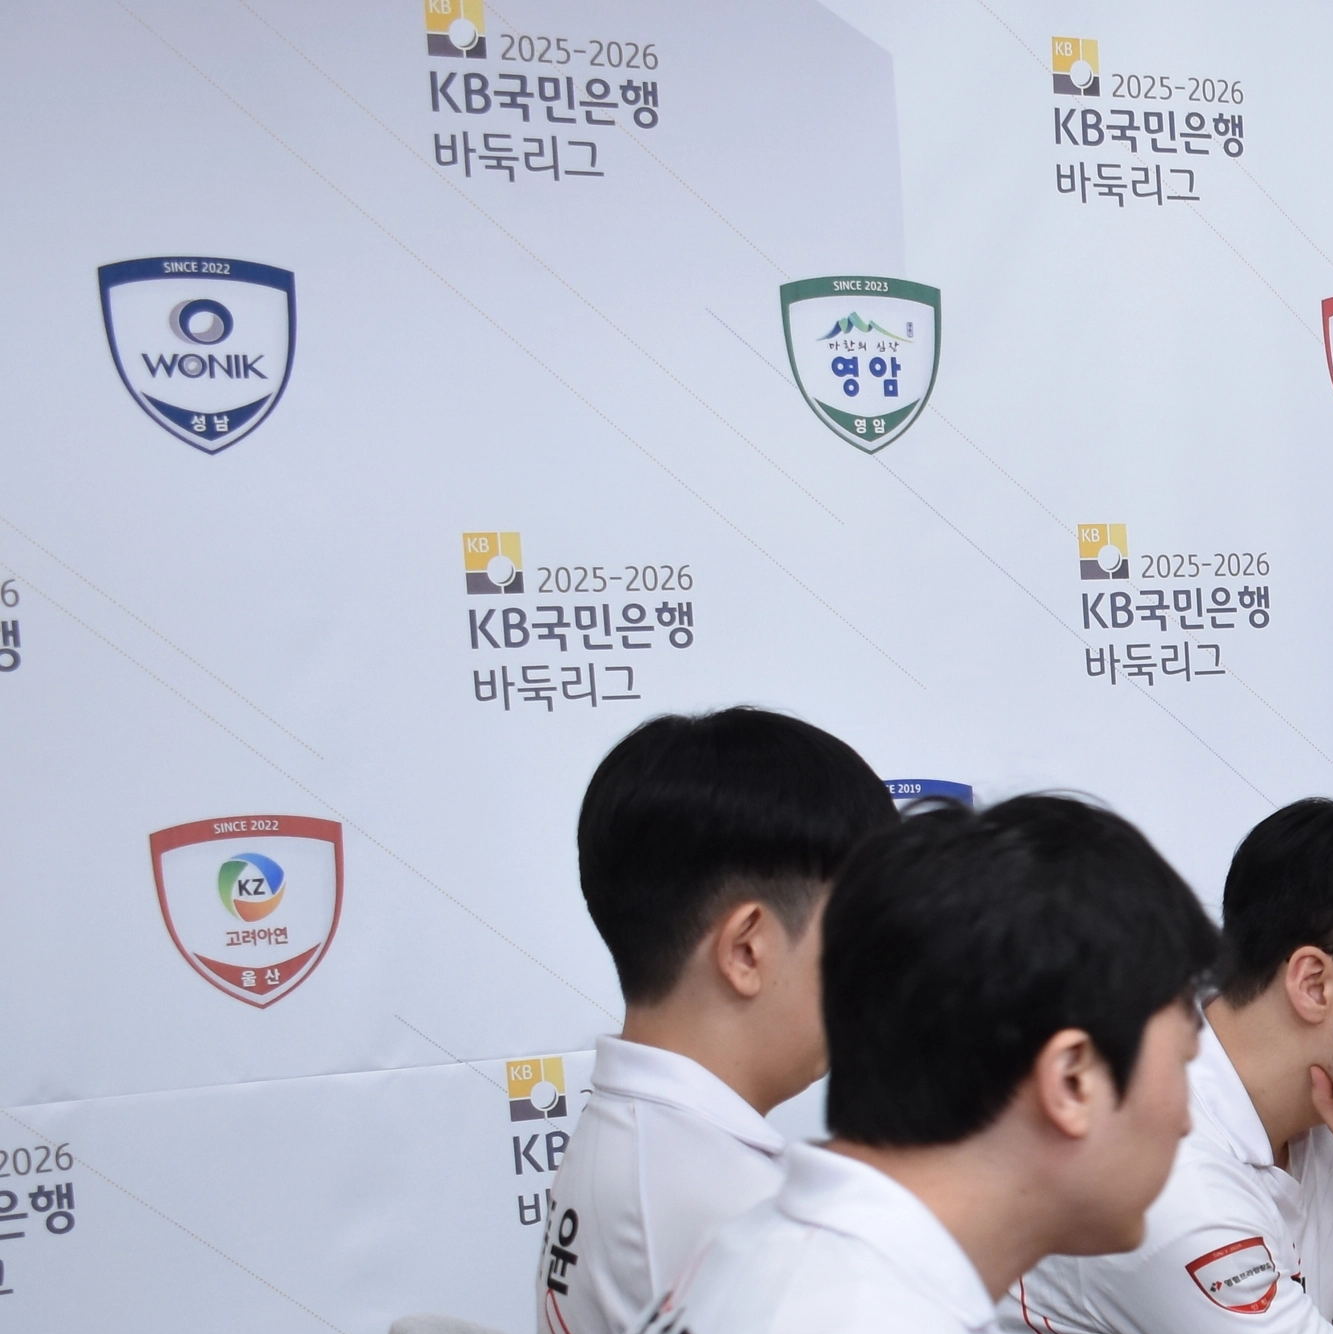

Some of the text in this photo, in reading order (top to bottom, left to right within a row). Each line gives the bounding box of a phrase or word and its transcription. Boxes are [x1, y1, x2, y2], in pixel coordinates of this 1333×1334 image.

[428, 0, 452, 14] KB
[500, 33, 659, 71] 2025-2026
[1055, 41, 1073, 57] KB
[429, 70, 659, 130] KB국민은행
[1111, 73, 1244, 105] 2025-2026
[1054, 107, 1244, 158] KB국민은행
[433, 130, 605, 183] 바둑리그
[1055, 161, 1201, 208] 바둑리그
[163, 261, 231, 275] SINCE 2022
[833, 280, 889, 292] SINCE 2023
[141, 353, 268, 380] WONIK
[830, 355, 902, 398] 영암
[190, 414, 229, 432] 성남
[854, 418, 886, 434] 영암
[466, 537, 490, 553] KB
[1081, 527, 1100, 543] KB
[1140, 551, 1270, 579] 2025-2026
[537, 564, 693, 594] 2025-2026
[1081, 585, 1270, 632] KB국민은행
[468, 601, 694, 652] KB국민은행
[1085, 640, 1226, 687] 바둑리그
[473, 662, 641, 713] 바둑리그
[213, 819, 279, 835] SINCE 2022
[237, 877, 266, 899] KZ
[225, 926, 289, 947] 고려아연
[240, 968, 282, 987] 울산
[510, 1064, 533, 1081] KB
